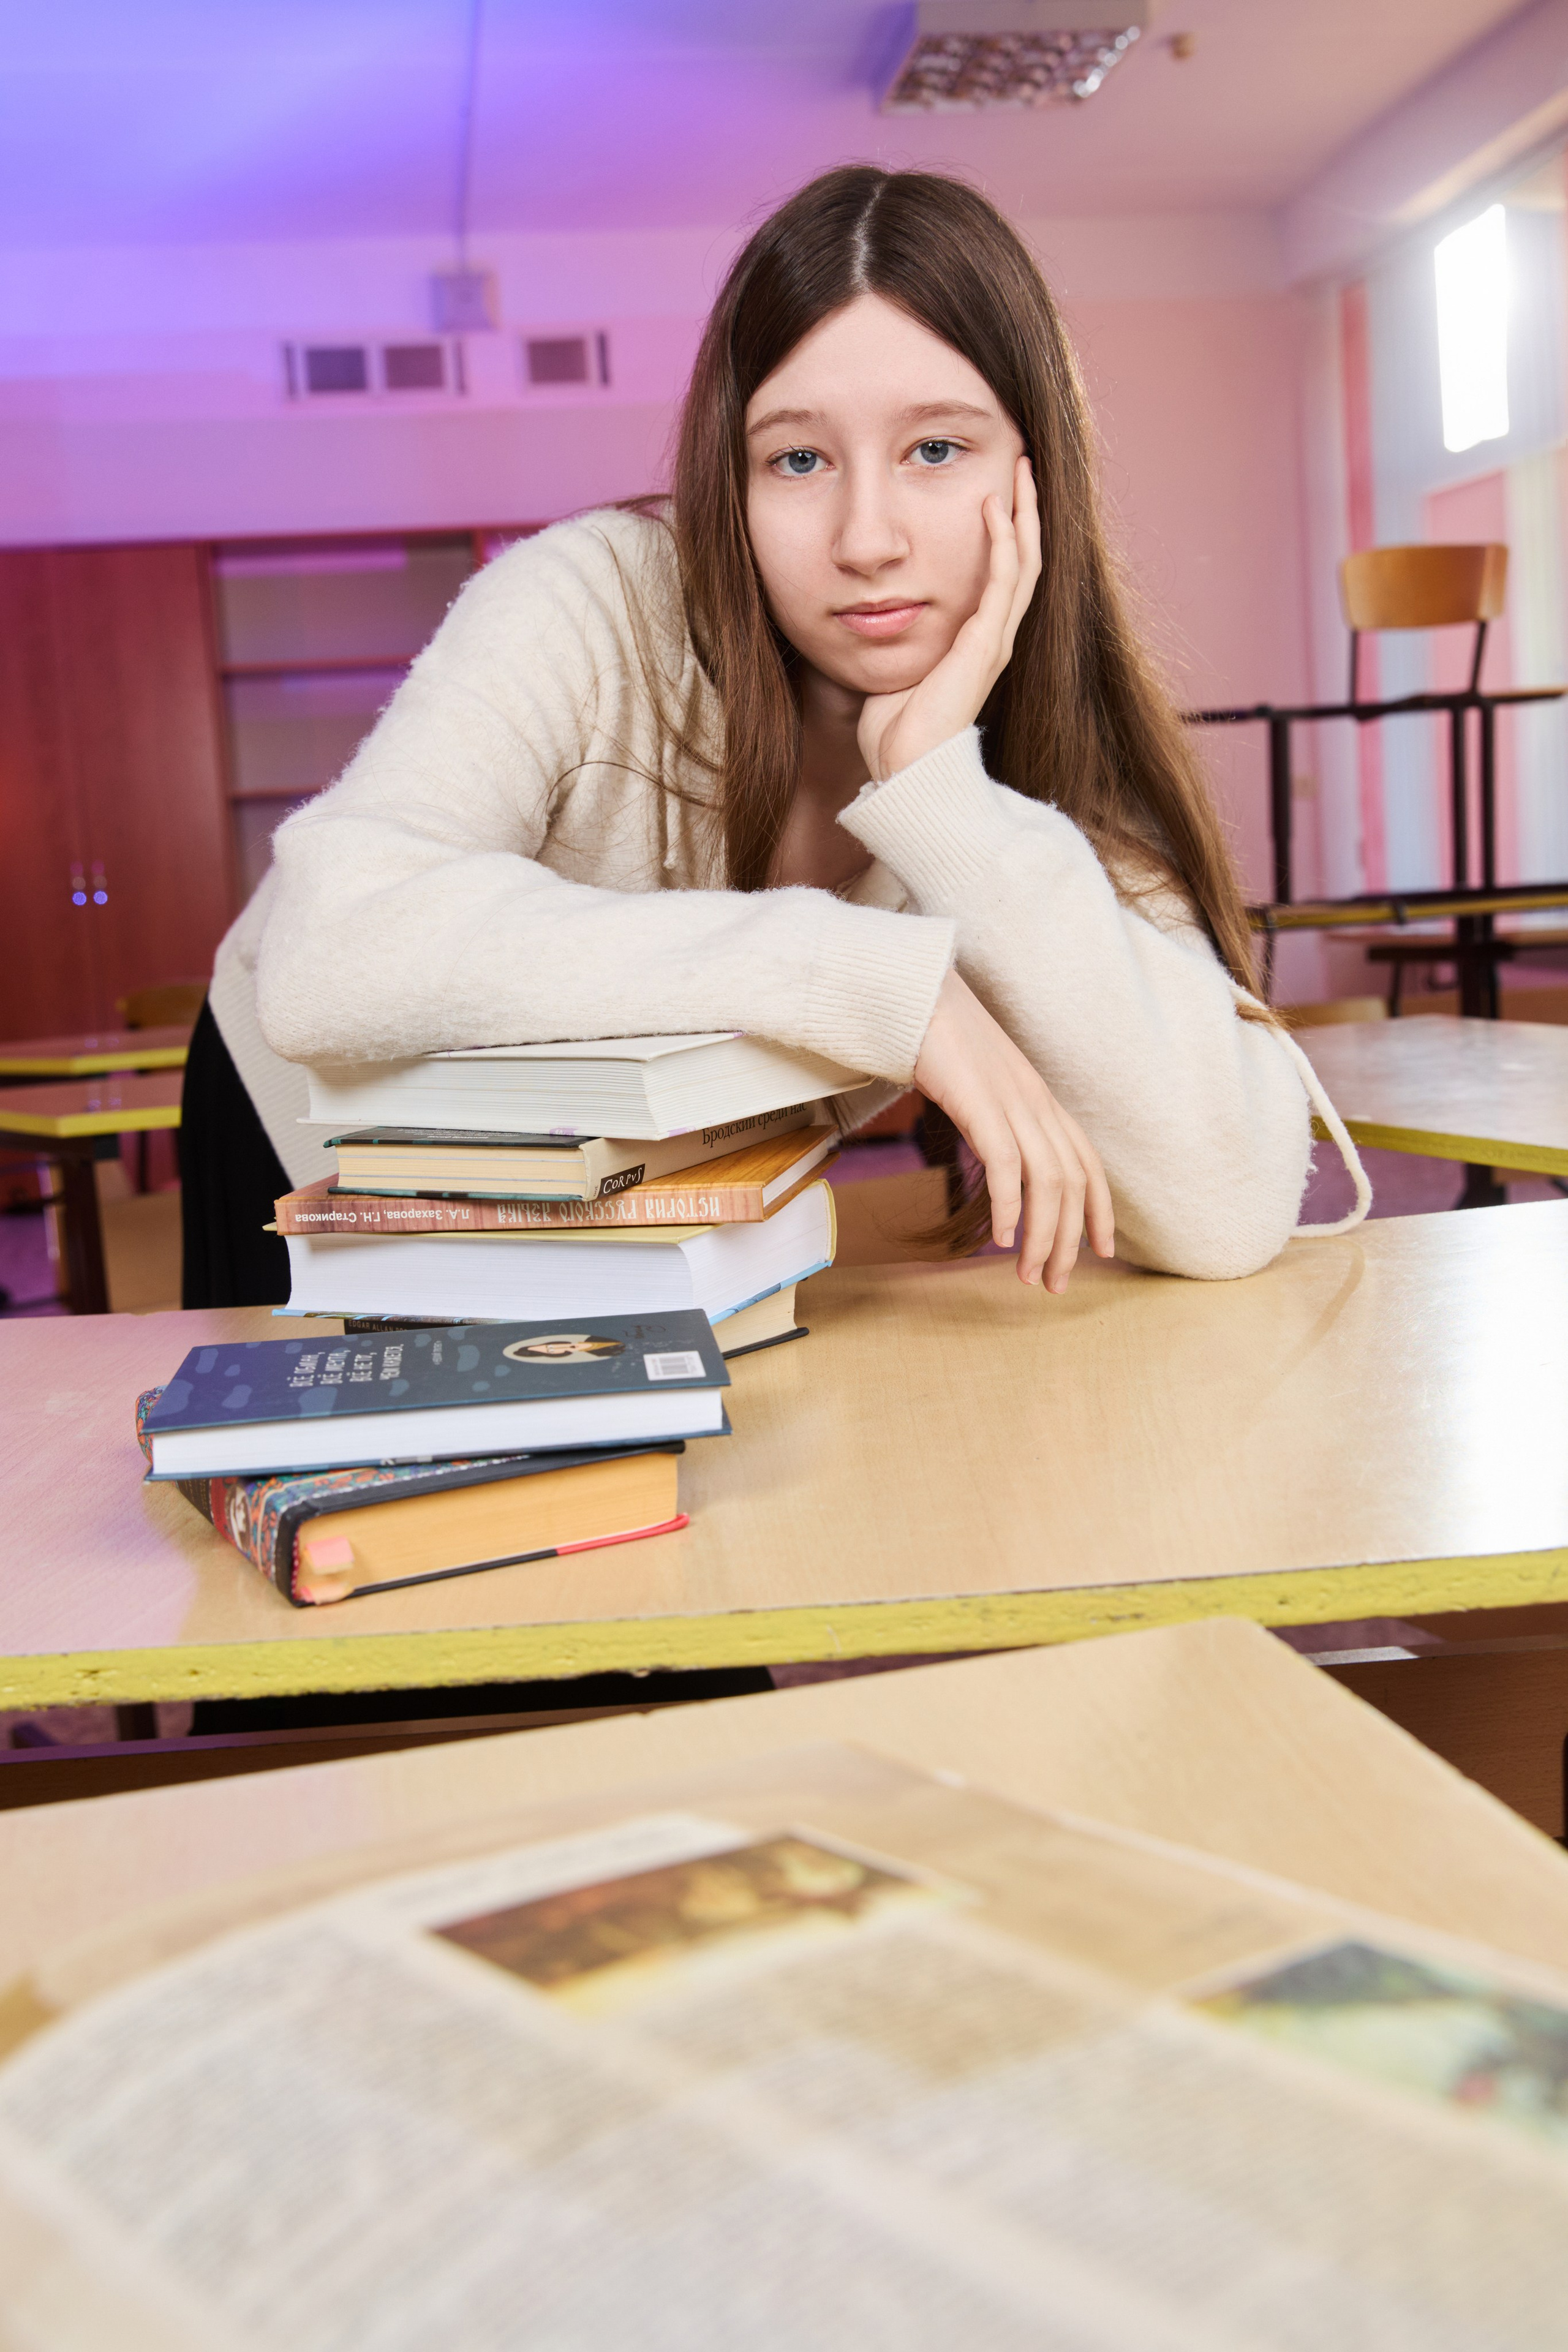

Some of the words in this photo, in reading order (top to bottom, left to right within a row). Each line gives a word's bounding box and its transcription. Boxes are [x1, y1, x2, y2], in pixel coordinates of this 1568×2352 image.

[758, 1107, 788, 1130] среди
[790, 1102, 808, 1115] нас
[383, 1208, 443, 1220] Захарова,
[446, 1208, 470, 1219] Л.А.
[497, 1202, 552, 1224] ЯЗЫКА
[559, 1199, 637, 1222] РУССКОГО
[645, 1196, 720, 1219] ИСТОРИЯ
[295, 1210, 357, 1223] Старикова
[360, 1211, 380, 1223] Г.Н.
[349, 1319, 370, 1330] EDGAR
[372, 1324, 393, 1332] ALLAN
